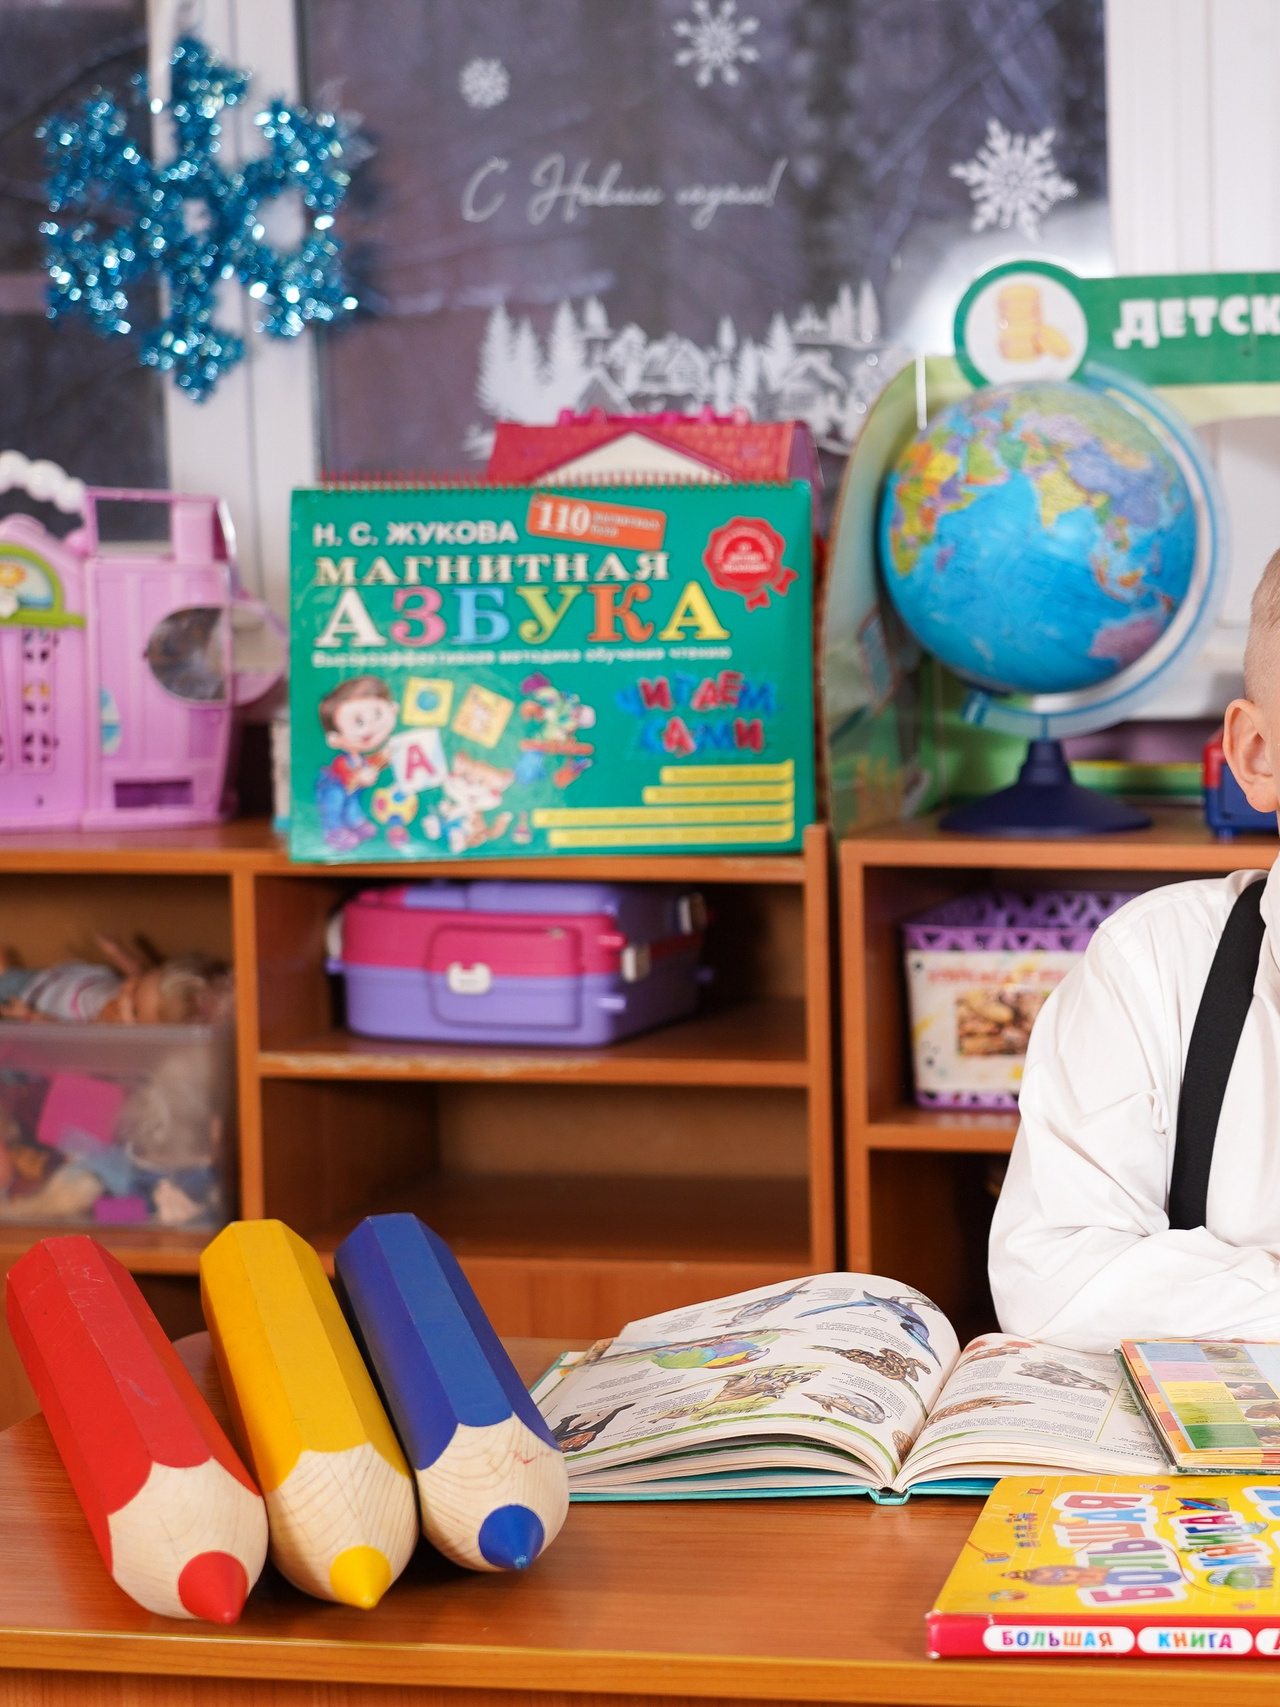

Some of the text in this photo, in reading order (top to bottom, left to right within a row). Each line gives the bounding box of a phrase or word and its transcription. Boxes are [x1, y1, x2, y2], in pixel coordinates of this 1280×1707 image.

[312, 519, 519, 547] Н. С. ЖУКОВА
[538, 502, 592, 536] 110
[314, 552, 670, 586] МАГНИТНАЯ
[314, 581, 731, 648] АЗБУКА
[615, 670, 777, 717] ЧИТАЕМ
[641, 716, 764, 757] САМИ
[1062, 1493, 1184, 1605] БОЛЬШАЯ
[1001, 1630, 1114, 1648] БОЛЬШАЯ
[1158, 1631, 1234, 1650] КНИГА
